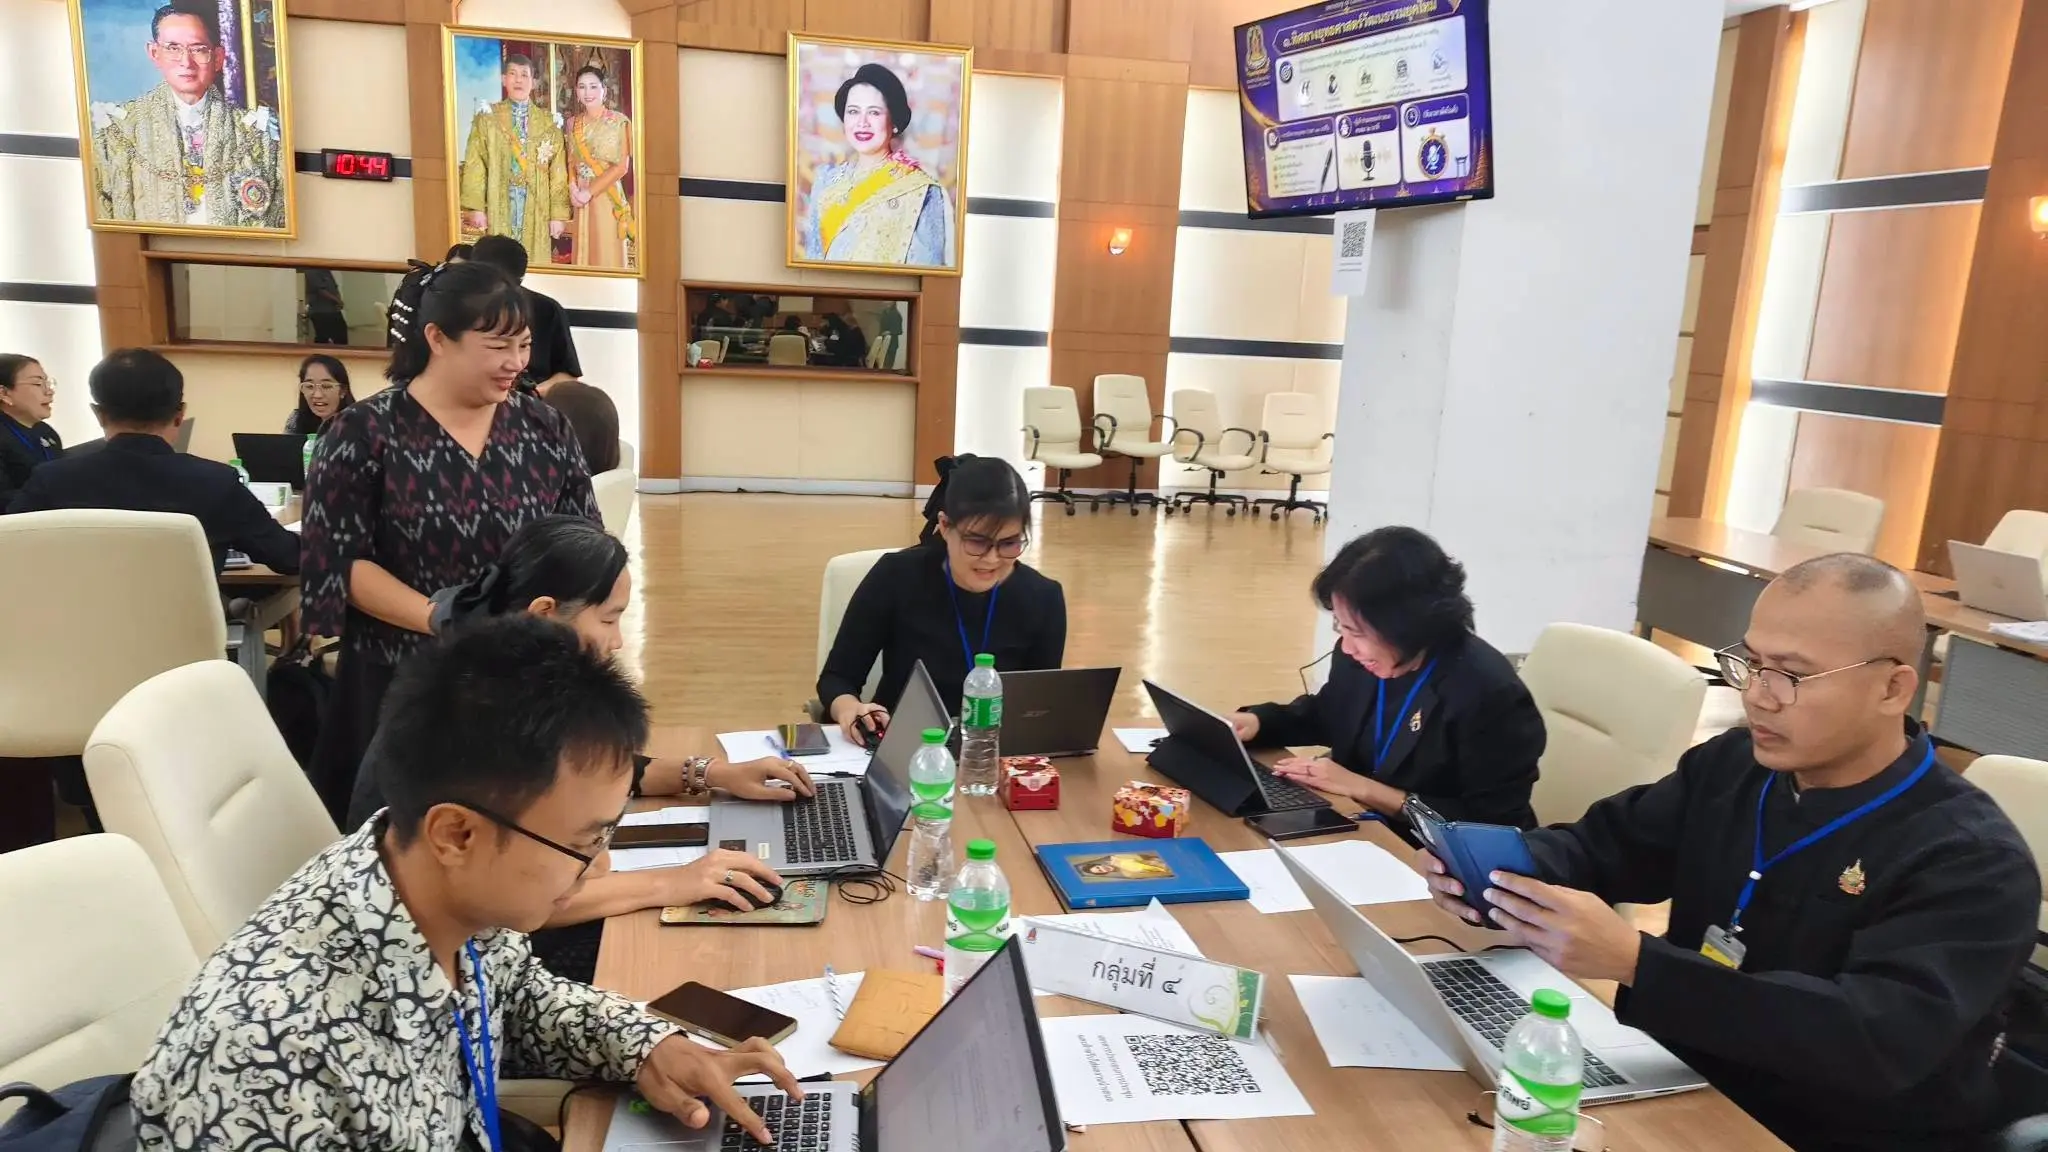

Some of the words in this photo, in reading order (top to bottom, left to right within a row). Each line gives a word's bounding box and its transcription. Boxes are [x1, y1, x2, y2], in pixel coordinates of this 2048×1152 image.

[1092, 957, 1157, 991] กลุ่มที่
[1162, 977, 1184, 995] ๔
